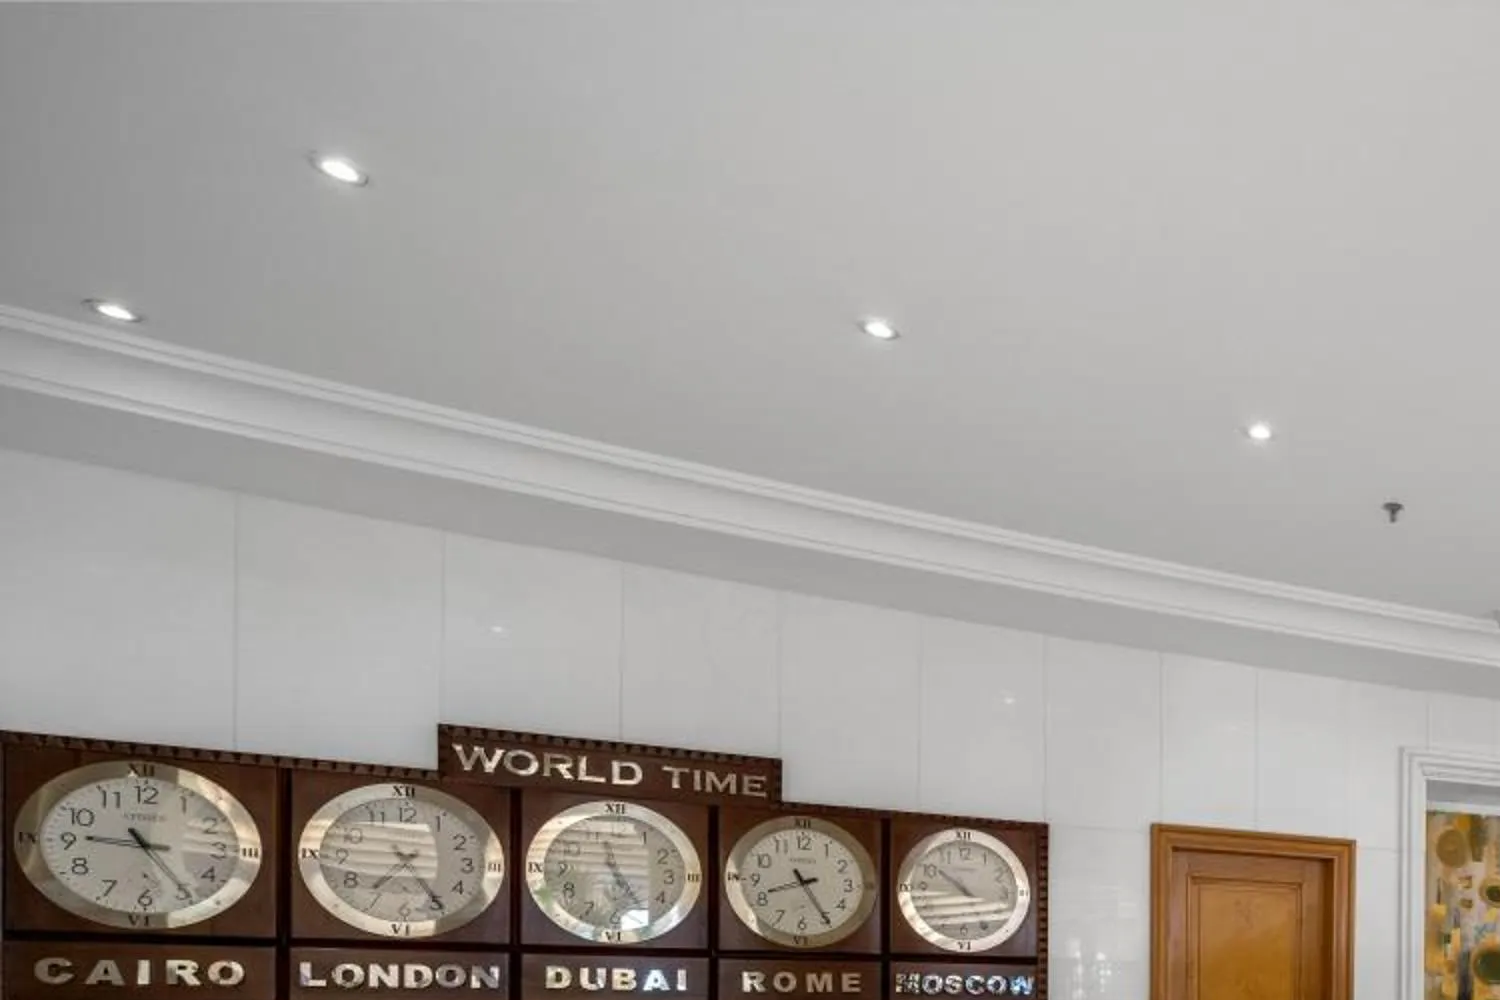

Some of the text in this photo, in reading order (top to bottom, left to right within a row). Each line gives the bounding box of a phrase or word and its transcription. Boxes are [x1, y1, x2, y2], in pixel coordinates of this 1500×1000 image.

[452, 743, 768, 797] WORLD TIME
[100, 788, 121, 809] 11
[134, 785, 158, 804] 12
[392, 786, 415, 797] XII
[180, 796, 187, 813] 1
[605, 804, 625, 814] XII
[70, 808, 94, 826] 10
[368, 809, 385, 824] 11
[399, 808, 417, 823] 12
[204, 818, 217, 833] 2
[435, 815, 441, 831] 1
[19, 831, 39, 844] IX
[60, 833, 76, 850] 9
[453, 835, 466, 850] 2
[642, 832, 647, 844] 1
[796, 836, 812, 850] 12
[211, 842, 227, 860] 3
[243, 847, 258, 857] III
[301, 848, 319, 858] IX
[775, 838, 788, 854] 11
[824, 843, 829, 856] 1
[336, 849, 349, 864] 9
[657, 850, 670, 864] 2
[758, 853, 771, 868] 10
[72, 857, 88, 875] 8
[461, 858, 474, 873] 3
[488, 862, 500, 872] III
[528, 862, 543, 872] IX
[837, 860, 848, 873] 2
[924, 864, 937, 878] 10
[201, 866, 216, 881] 4
[344, 872, 358, 888] 8
[664, 870, 674, 884] 3
[688, 873, 700, 881] III
[751, 873, 760, 886] 9
[102, 880, 117, 896] 7
[176, 883, 191, 900] 5
[452, 881, 464, 894] 4
[563, 882, 574, 897] 8
[844, 879, 853, 892] 3
[138, 889, 152, 906] 6
[429, 896, 443, 910] 5
[655, 891, 665, 904] 4
[758, 891, 768, 906] 8
[584, 902, 594, 916] 7
[836, 899, 846, 911] 4
[128, 915, 149, 926] VI
[610, 911, 621, 925] 6
[776, 910, 785, 924] 7
[798, 916, 806, 930] 6
[391, 925, 409, 935] VI
[605, 932, 620, 941] VI
[960, 924, 968, 935] 6
[33, 957, 246, 986] CAIRO
[300, 961, 500, 989] LONDON
[545, 965, 687, 992] DUBAI
[742, 971, 862, 993] ROME
[895, 973, 1035, 995] MOSCOW
